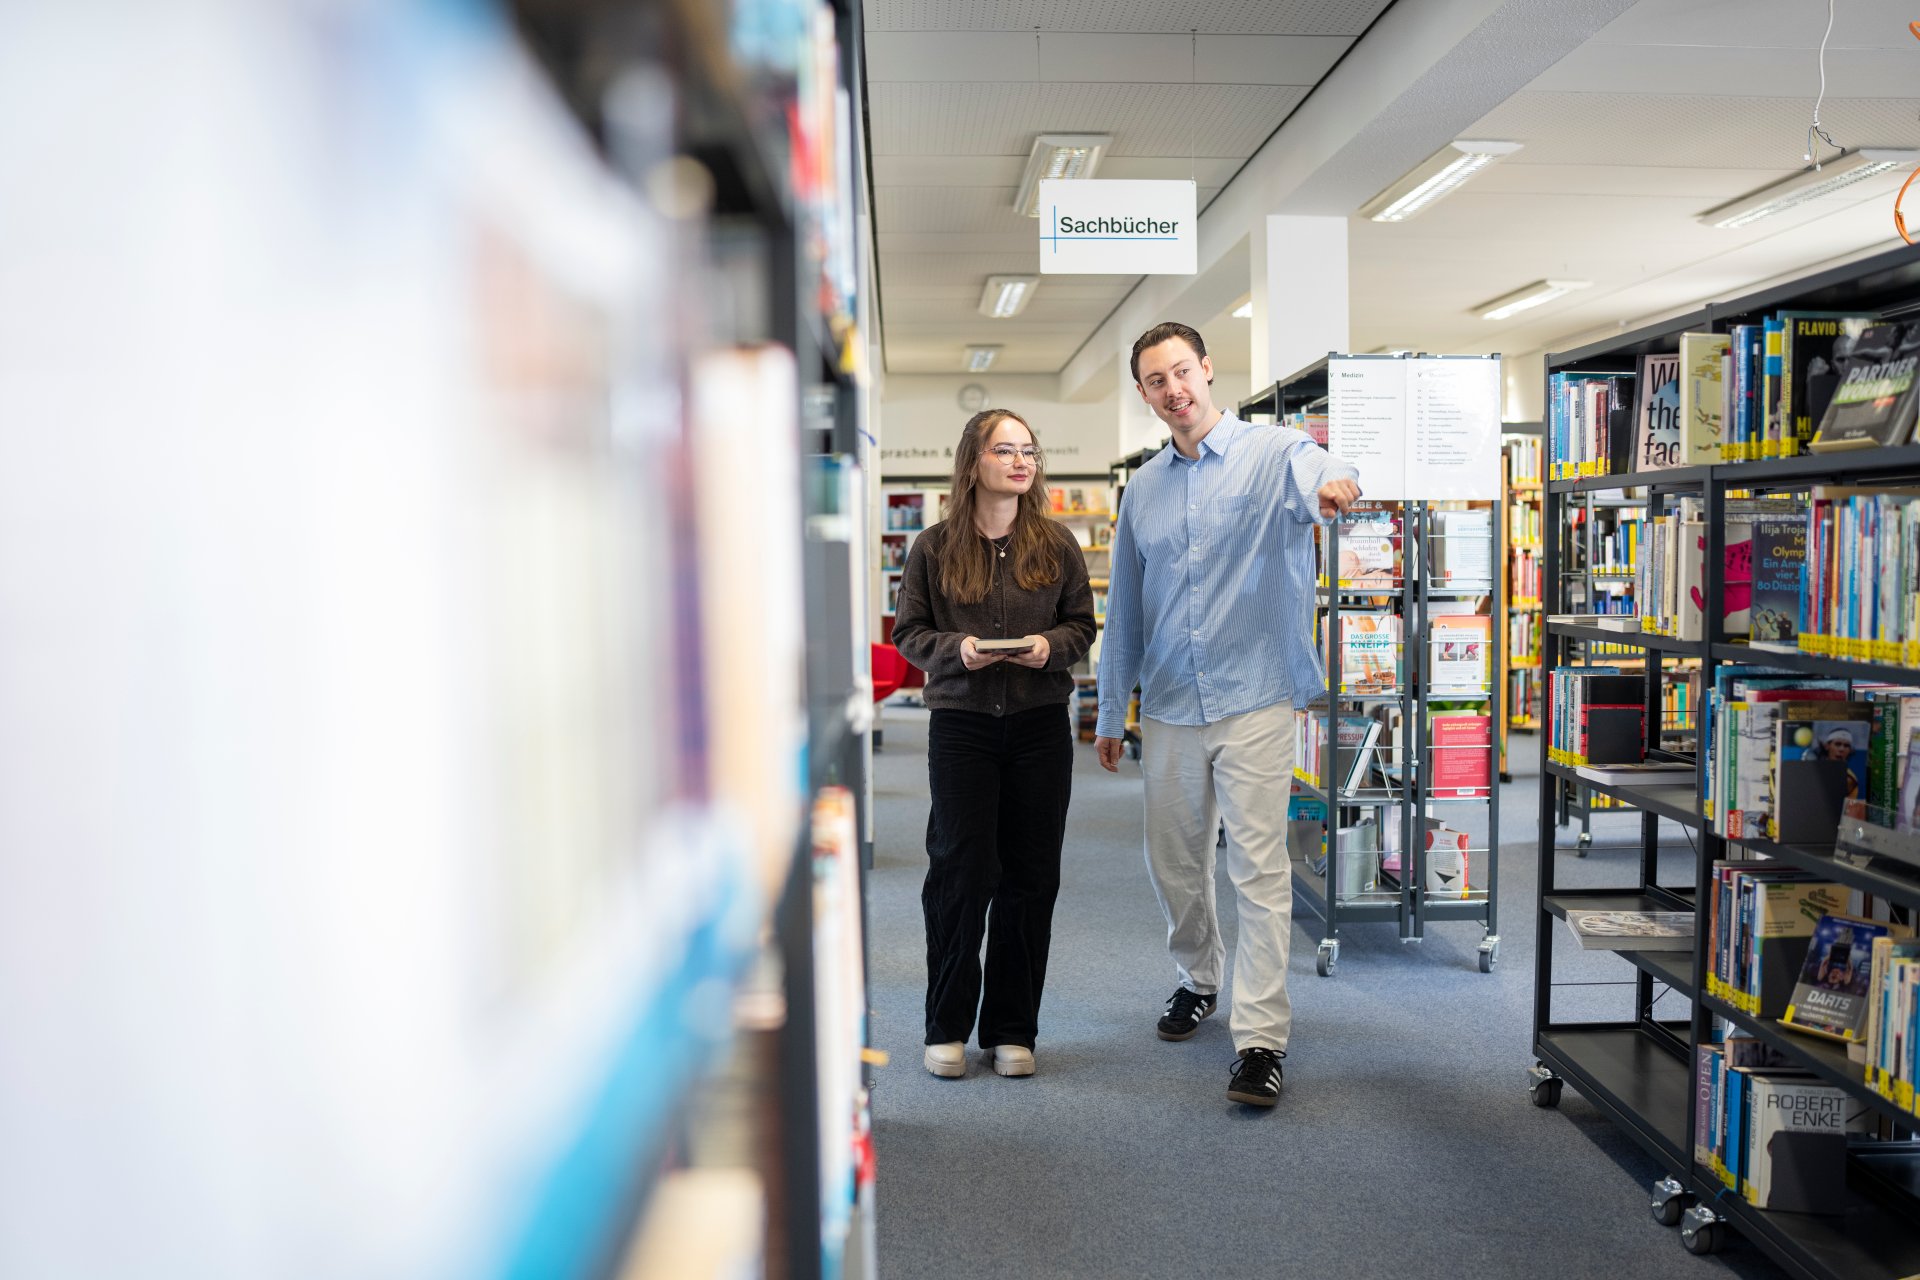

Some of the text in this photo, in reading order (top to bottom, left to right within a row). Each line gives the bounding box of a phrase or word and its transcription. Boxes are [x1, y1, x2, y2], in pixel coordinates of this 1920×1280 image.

[1060, 216, 1179, 234] Sachbücher
[1798, 321, 1836, 336] FLAVIO
[1846, 356, 1917, 384] PARTNER
[1647, 398, 1681, 430] the
[880, 447, 937, 460] prachen
[1644, 432, 1681, 466] fac
[1761, 523, 1806, 536] Ilija Troja
[1772, 546, 1806, 559] Olymp
[1762, 558, 1779, 568] Ein
[1775, 570, 1794, 579] vier
[1757, 580, 1800, 592] 80 Diszip
[1350, 640, 1390, 648] KNEIPP
[1807, 990, 1852, 1010] DARTS
[1700, 1053, 1712, 1101] OPEN
[1767, 1094, 1845, 1112] ROBERT
[1792, 1110, 1841, 1128] ENKE
